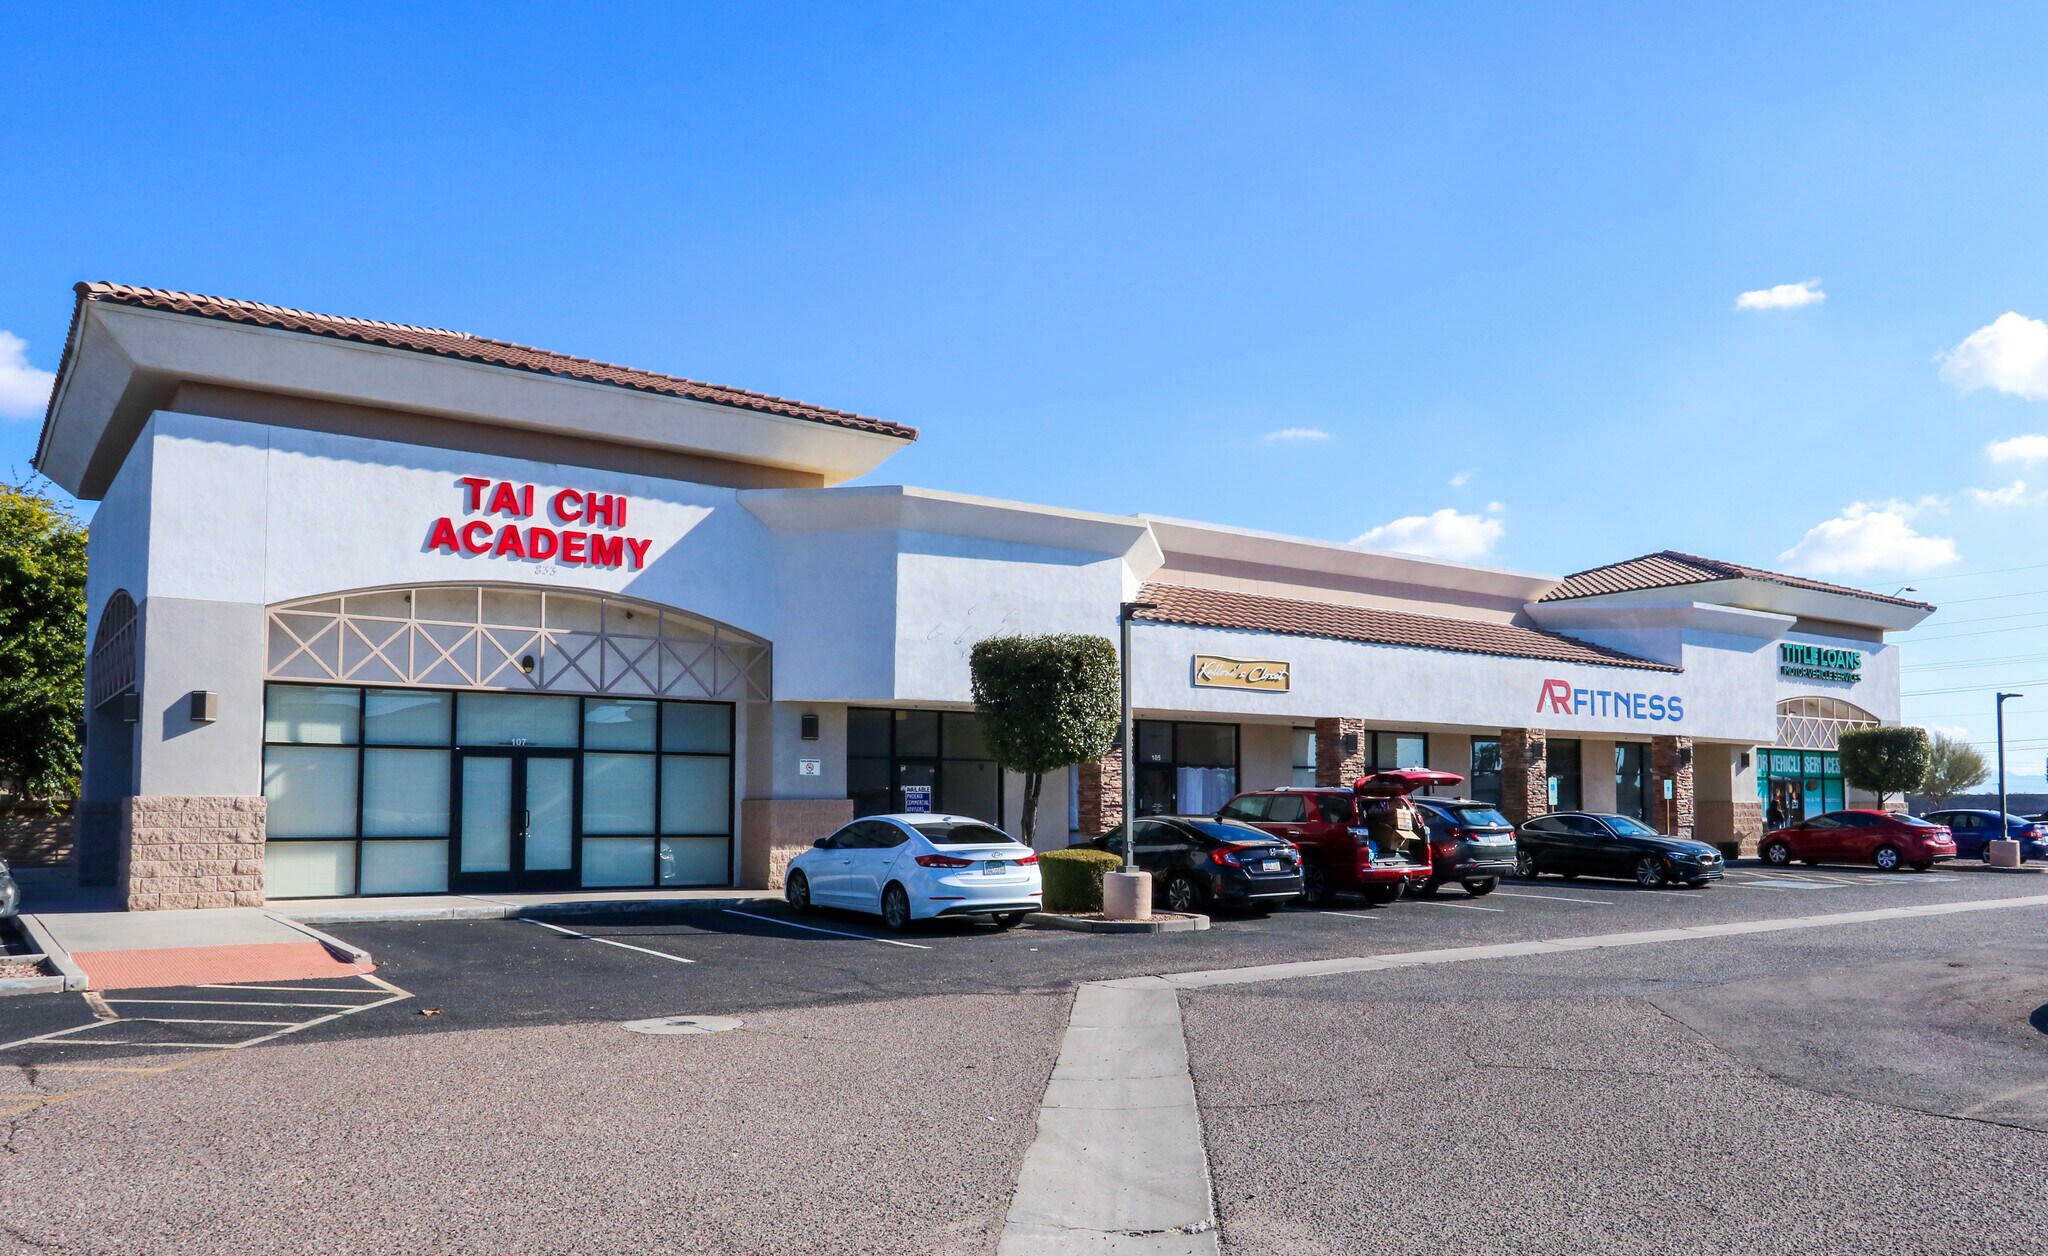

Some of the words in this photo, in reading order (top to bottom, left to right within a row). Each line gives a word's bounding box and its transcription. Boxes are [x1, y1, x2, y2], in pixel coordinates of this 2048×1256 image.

[462, 476, 535, 518] TAI
[553, 487, 627, 528] CHI
[428, 516, 654, 570] ACADEMY
[1782, 643, 1819, 666] TITLE
[1820, 647, 1862, 670] LOANS
[1247, 665, 1290, 683] Closet
[1782, 666, 1808, 678] MOTOR
[1807, 668, 1834, 681] VEHICLE
[1833, 670, 1862, 683] SERVICES
[511, 737, 527, 746] 107
